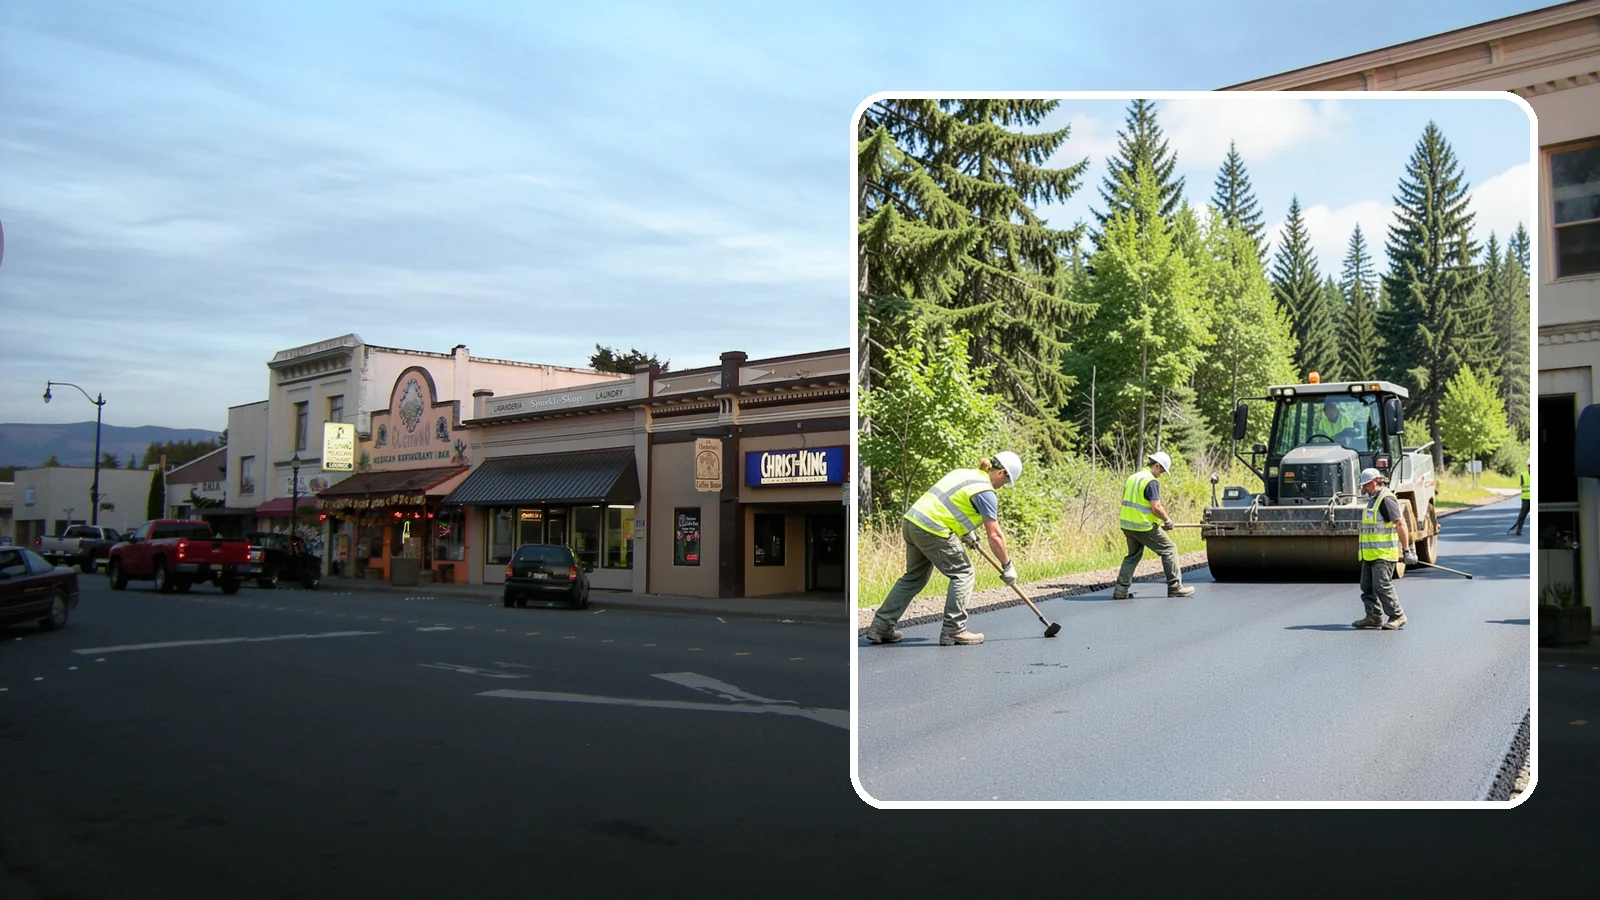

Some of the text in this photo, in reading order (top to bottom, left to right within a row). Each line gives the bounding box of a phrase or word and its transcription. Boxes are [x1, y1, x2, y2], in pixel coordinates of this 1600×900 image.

[493, 402, 523, 413] LAVANDERIA
[562, 394, 582, 405] Shop
[595, 389, 624, 400] LAUNDRY
[373, 455, 396, 464] MEXICAN
[397, 451, 433, 462] RESTAURANT
[437, 450, 450, 459] BAR
[760, 449, 827, 478] CHRIST KING
[696, 480, 709, 489] Coffee
